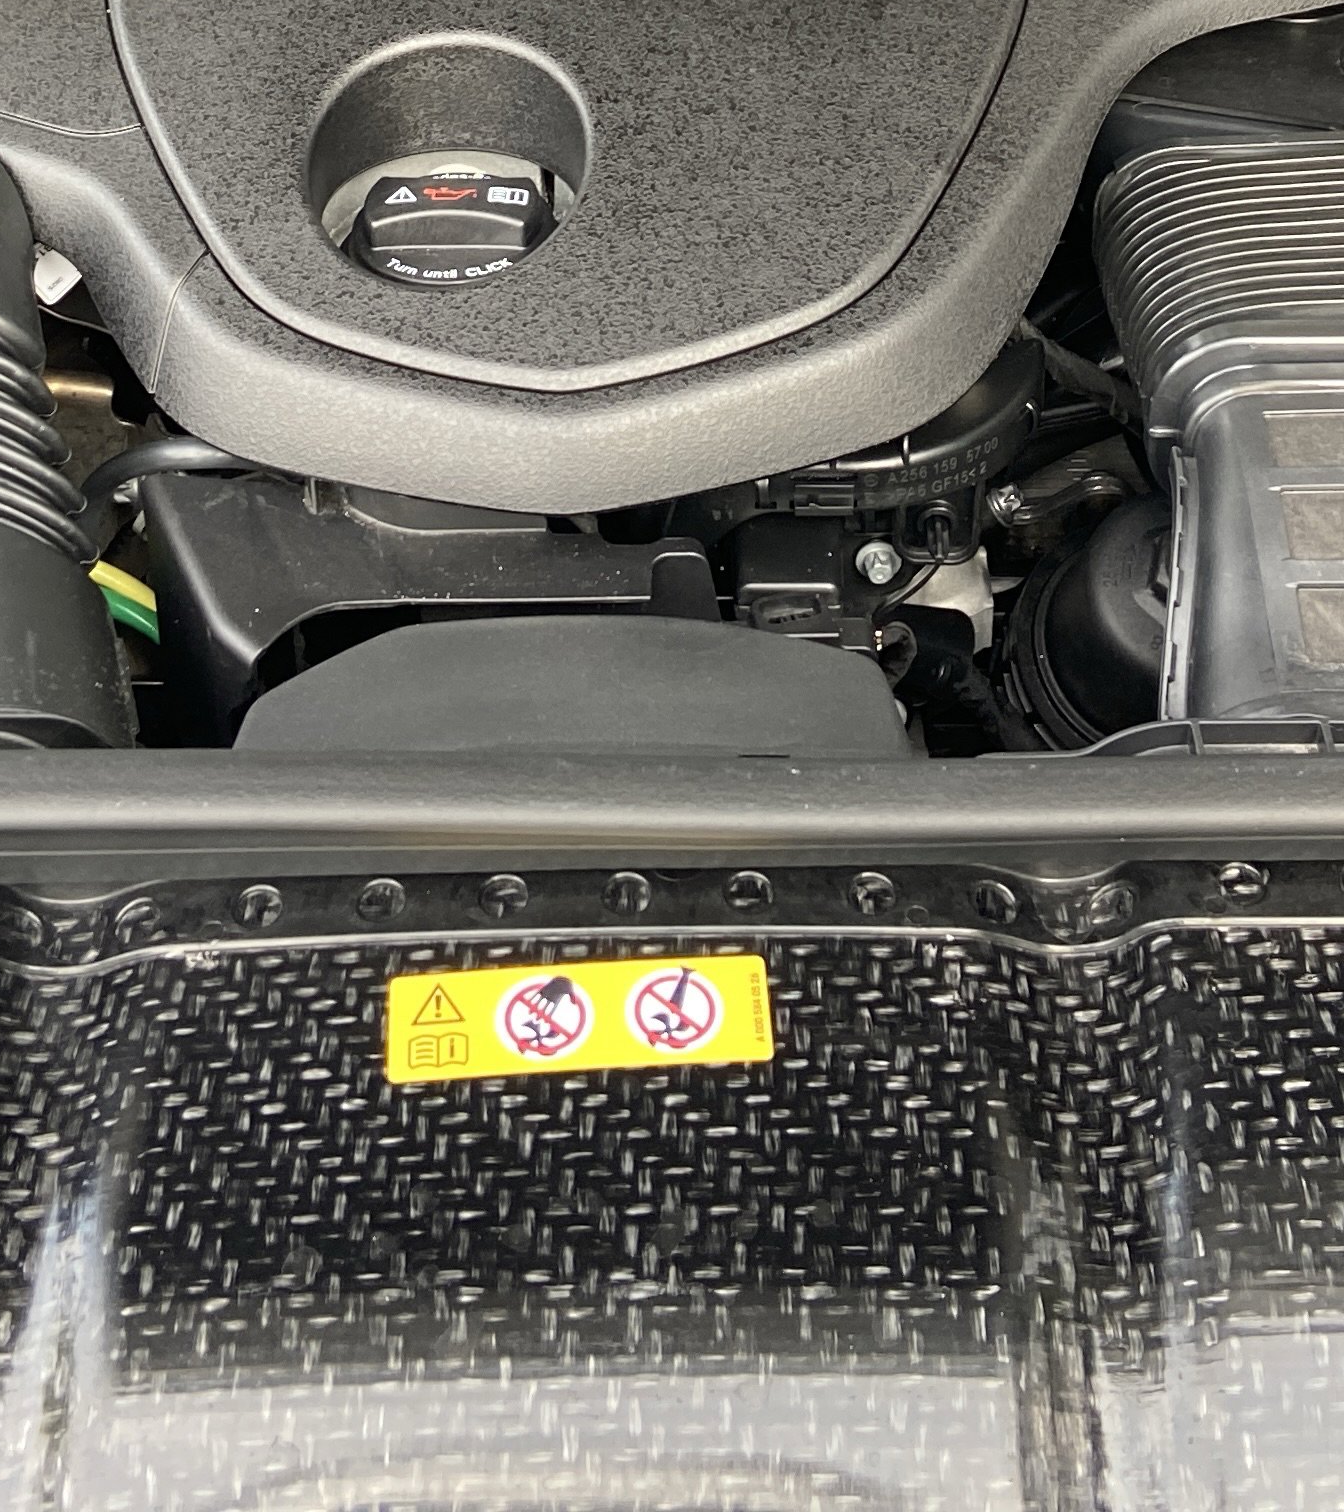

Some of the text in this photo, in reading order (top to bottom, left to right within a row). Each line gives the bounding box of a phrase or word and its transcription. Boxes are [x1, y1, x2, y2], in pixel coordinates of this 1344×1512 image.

[386, 257, 514, 279] Turn until CLICK
[933, 457, 958, 476] 159
[984, 436, 999, 454] 00
